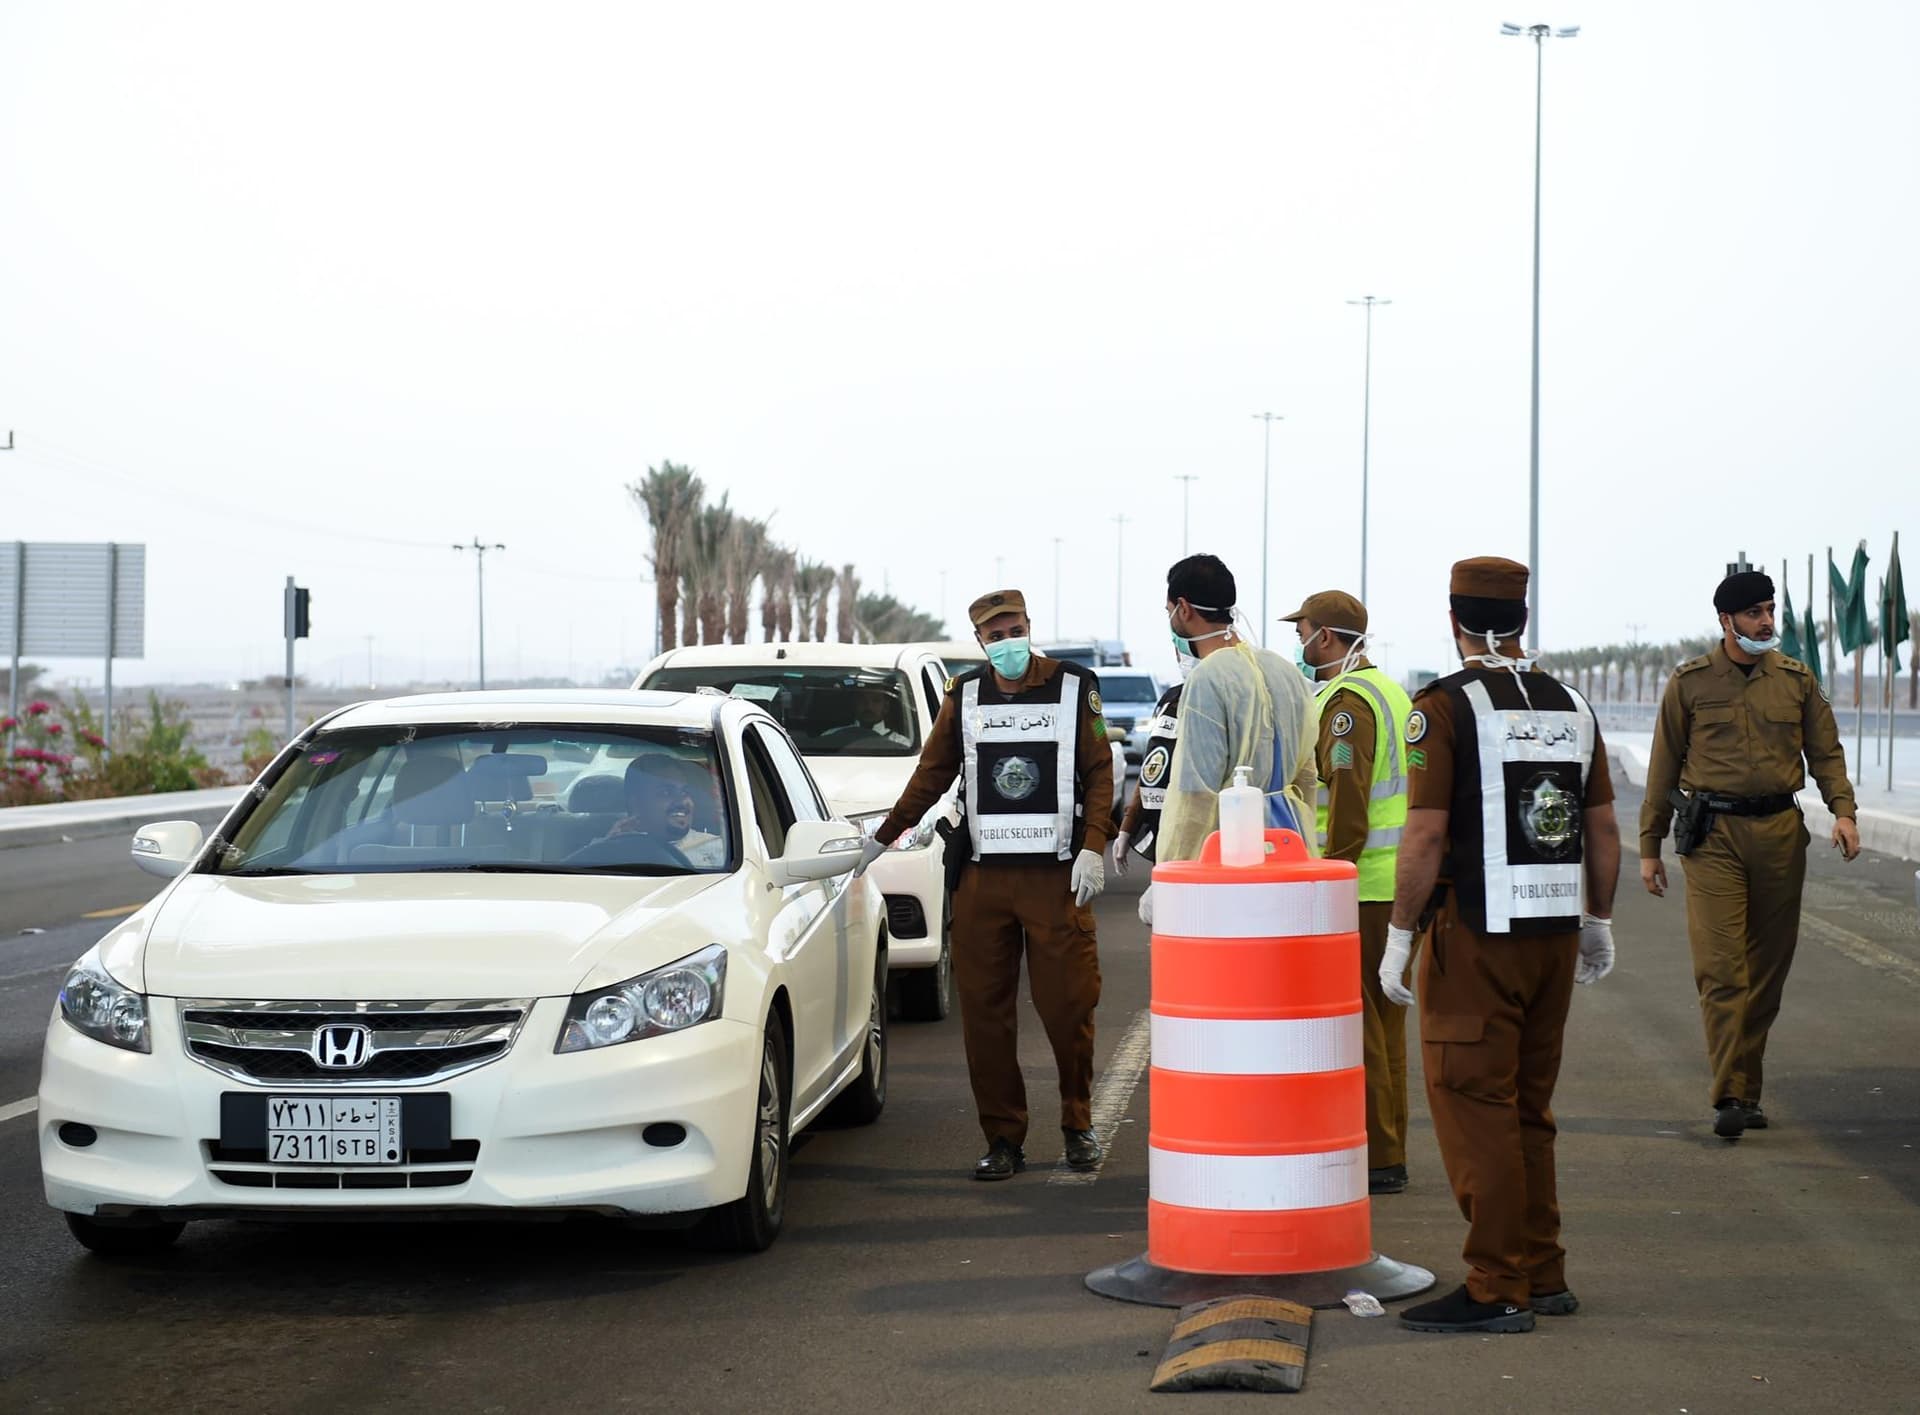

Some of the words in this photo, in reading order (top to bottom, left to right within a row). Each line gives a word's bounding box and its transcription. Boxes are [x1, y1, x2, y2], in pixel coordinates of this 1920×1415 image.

[979, 827, 1010, 840] PUBLIC
[1010, 826, 1055, 839] SECURITY
[1512, 883, 1550, 900] PUBLIC
[272, 1134, 327, 1160] 7311
[337, 1139, 376, 1156] STB
